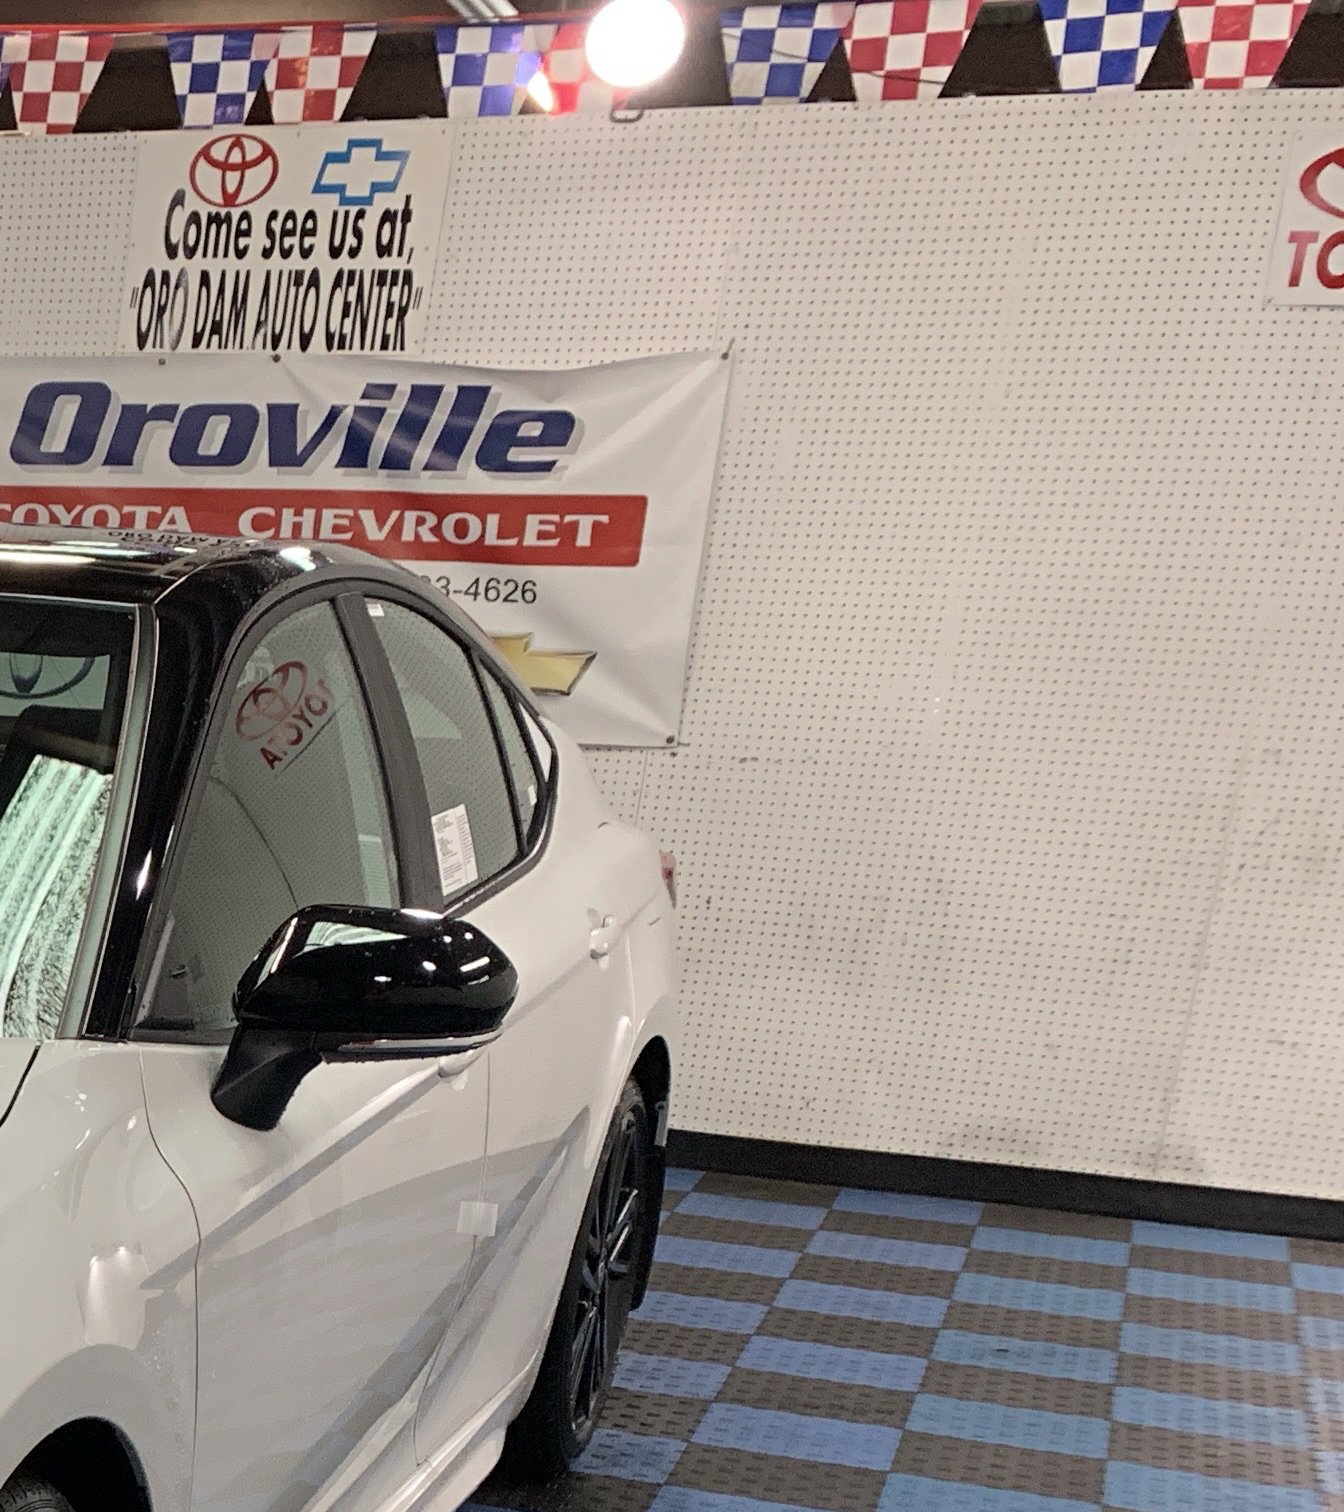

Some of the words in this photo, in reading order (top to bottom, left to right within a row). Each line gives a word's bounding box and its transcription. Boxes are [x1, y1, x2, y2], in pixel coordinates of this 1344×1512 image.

[164, 188, 253, 260] Come
[261, 207, 318, 260] see
[328, 207, 367, 260] us
[191, 268, 251, 351] DAM
[251, 266, 321, 353] AUTO
[324, 266, 423, 352] CENTER"
[9, 381, 577, 474] Oroville
[237, 505, 610, 548] CHEVROLET
